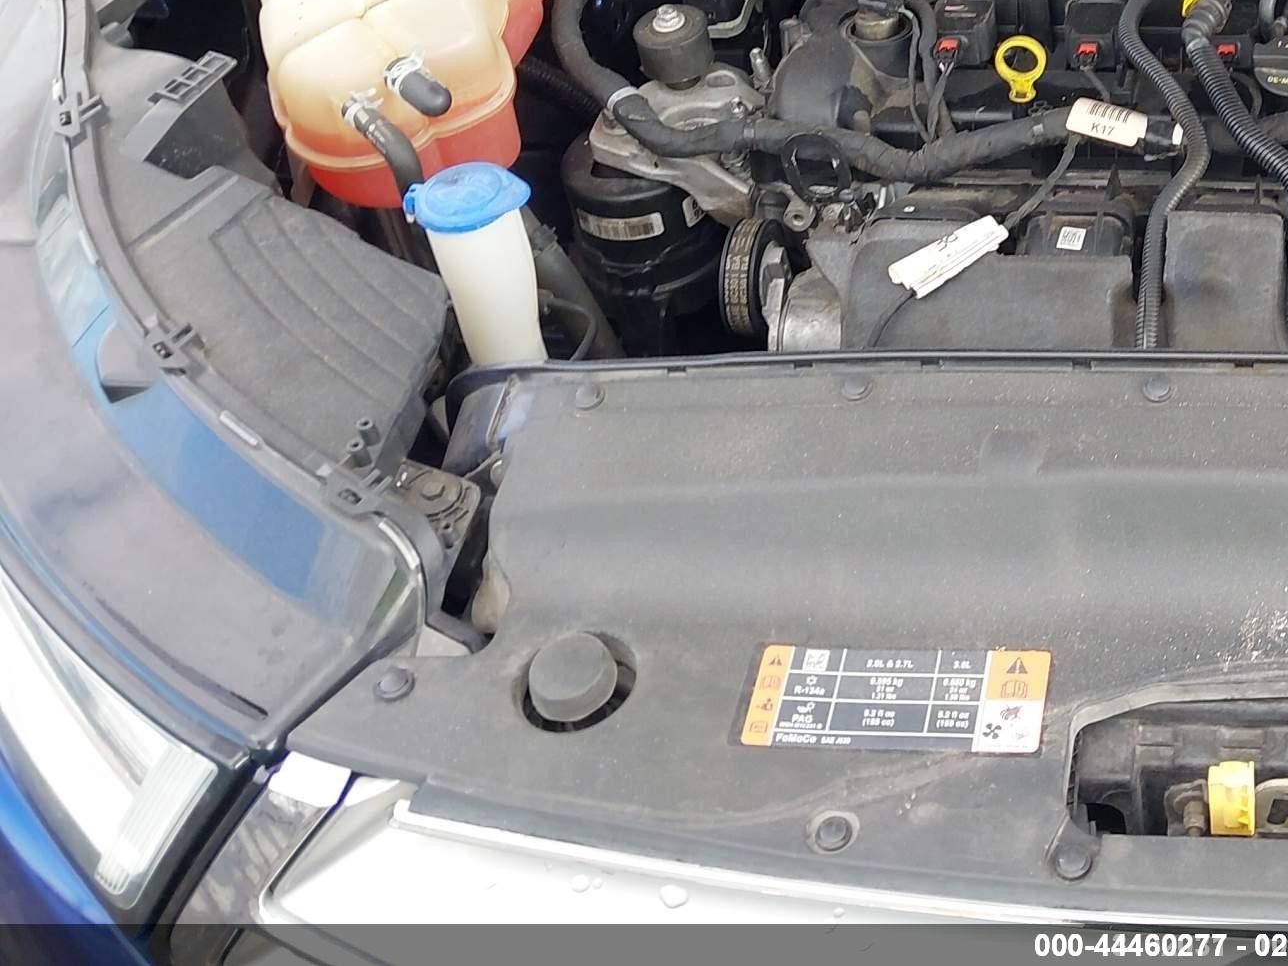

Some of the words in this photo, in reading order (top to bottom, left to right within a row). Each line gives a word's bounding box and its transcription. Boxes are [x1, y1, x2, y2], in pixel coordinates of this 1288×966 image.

[1091, 121, 1116, 136] K17
[794, 685, 826, 695] R-134a
[792, 714, 813, 723] PAG
[775, 733, 817, 743] FoMoCo
